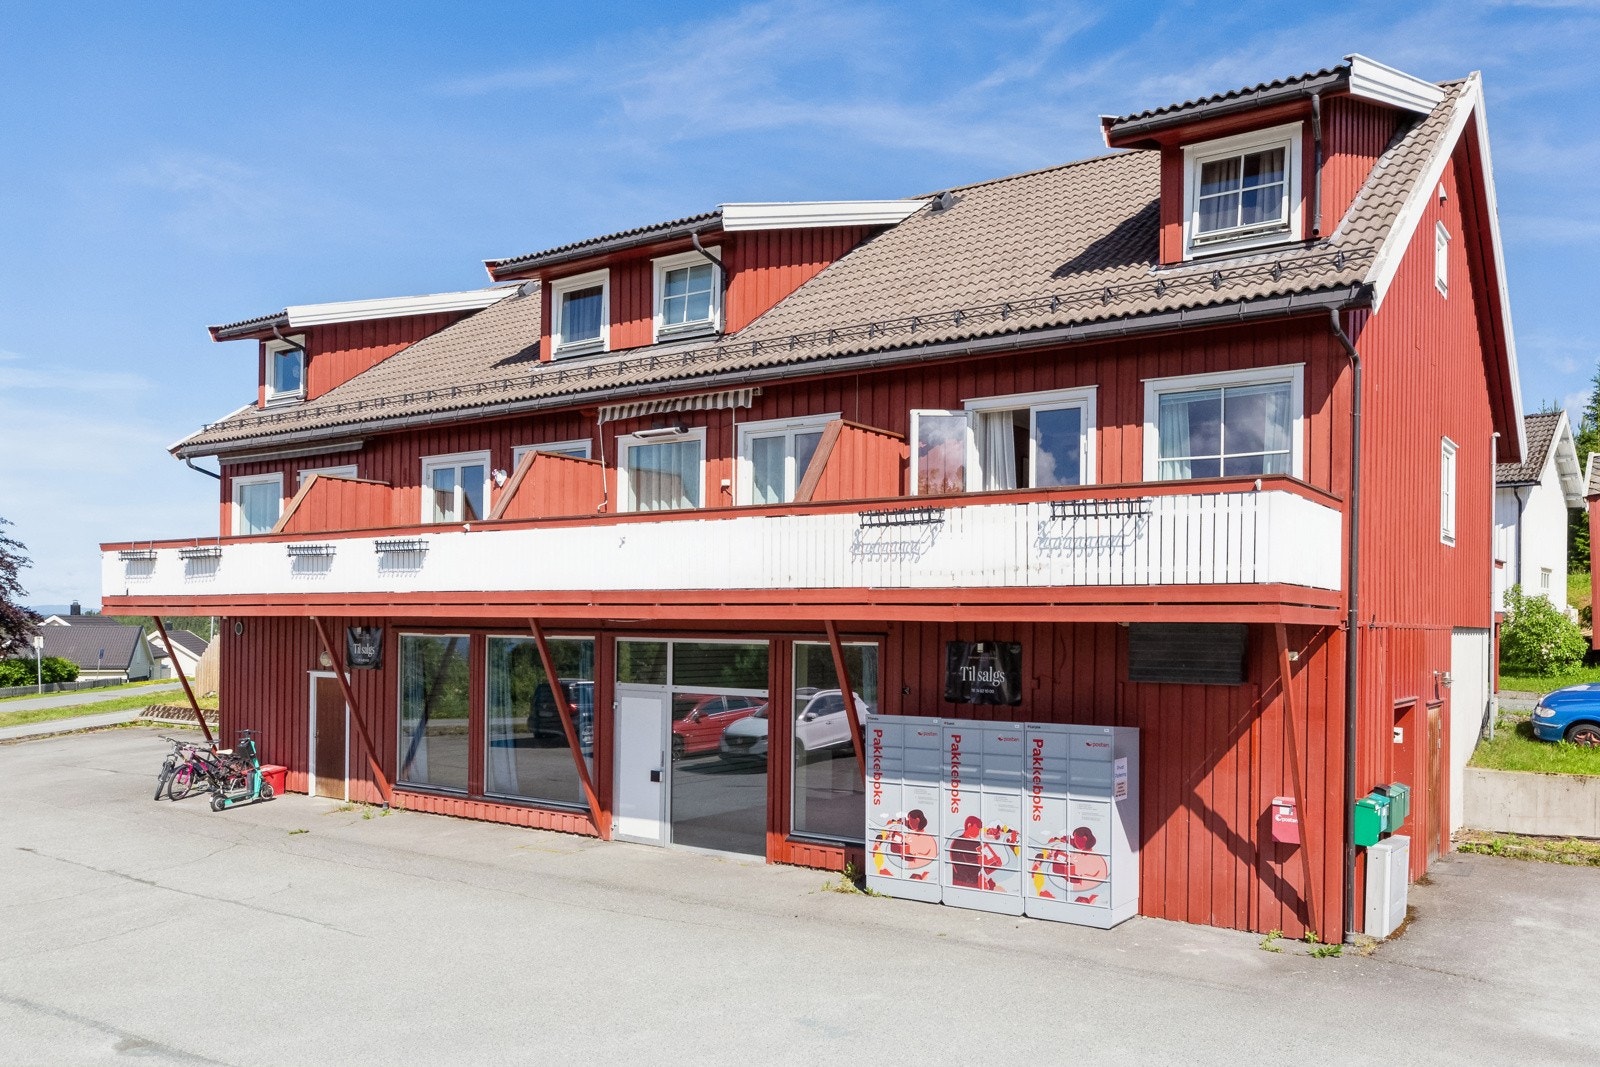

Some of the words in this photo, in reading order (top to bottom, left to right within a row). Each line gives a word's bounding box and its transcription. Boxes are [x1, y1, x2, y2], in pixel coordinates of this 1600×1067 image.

[353, 644, 361, 654] Til
[361, 643, 375, 657] salgs
[960, 665, 976, 681] Til
[977, 666, 1005, 687] salgs
[873, 729, 883, 806] Pakkeboks
[950, 734, 962, 814] Pakkeboks
[1032, 738, 1044, 822] Pakkeboks
